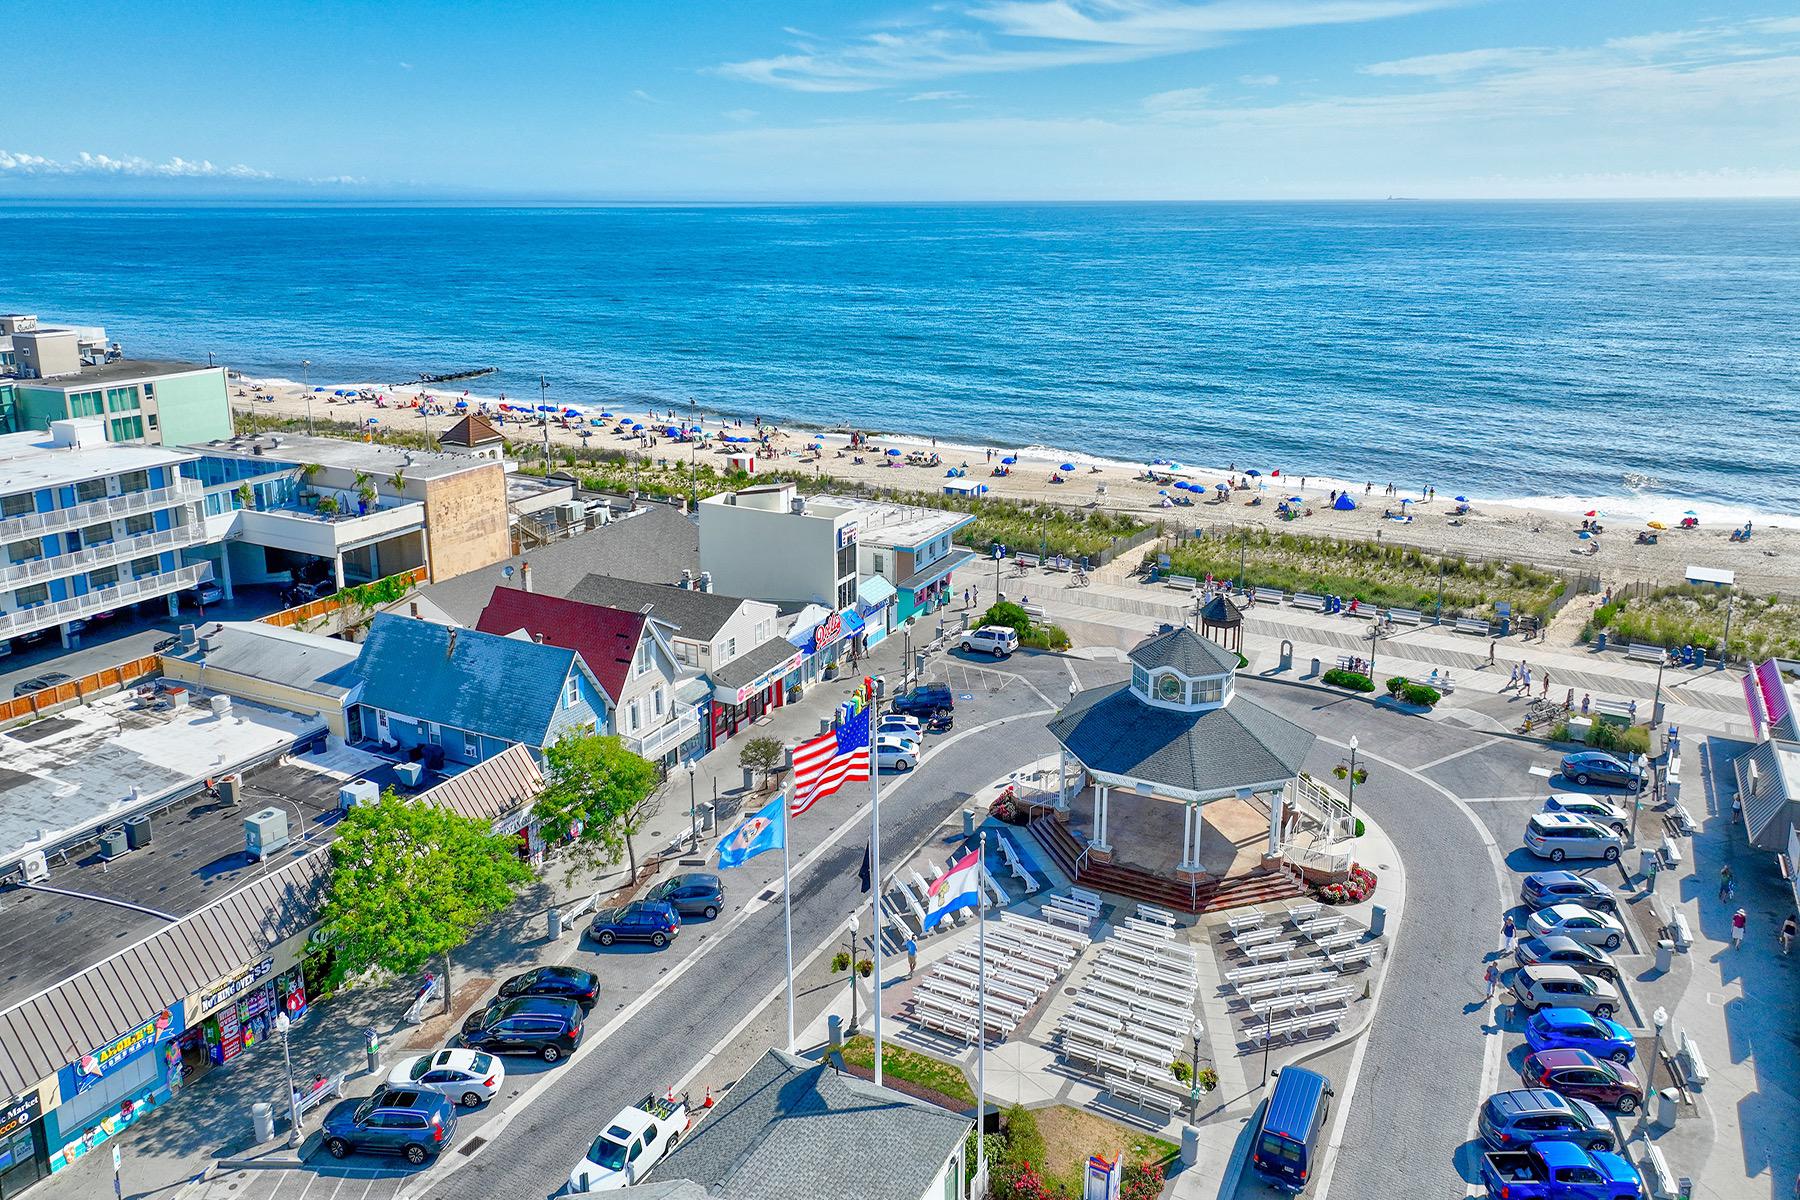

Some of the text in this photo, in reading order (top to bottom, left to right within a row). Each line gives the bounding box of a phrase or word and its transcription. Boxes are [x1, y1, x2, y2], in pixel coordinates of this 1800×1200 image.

[202, 983, 236, 1012] NOTHING
[235, 972, 256, 992] OVER
[7, 1096, 39, 1119] Market
